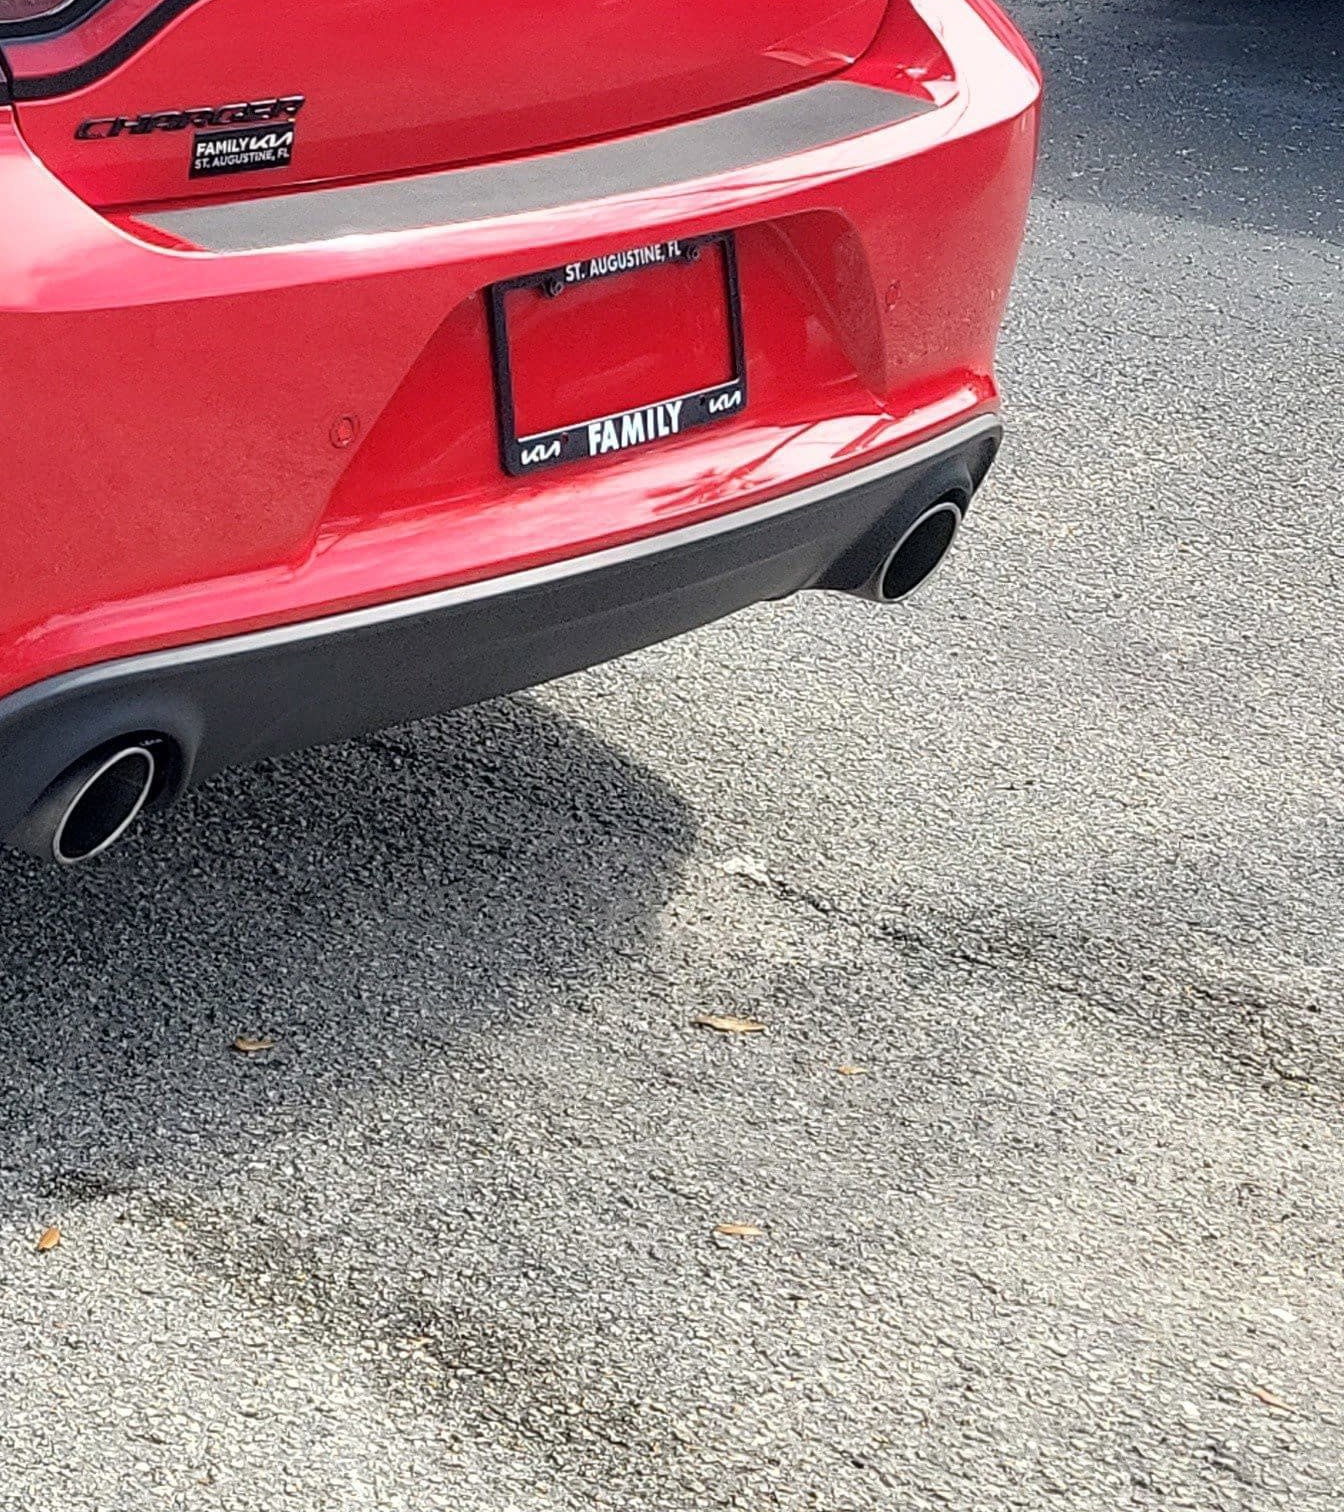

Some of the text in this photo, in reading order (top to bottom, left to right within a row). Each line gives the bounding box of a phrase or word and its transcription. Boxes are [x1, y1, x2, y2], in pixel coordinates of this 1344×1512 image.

[74, 95, 305, 140] CHARGER
[194, 148, 290, 170] ST. AUGUSTINE, FL
[196, 138, 248, 157] FAMILY
[566, 240, 682, 282] ST. AUGUSTINE, FL
[587, 399, 683, 457] FAMILY
